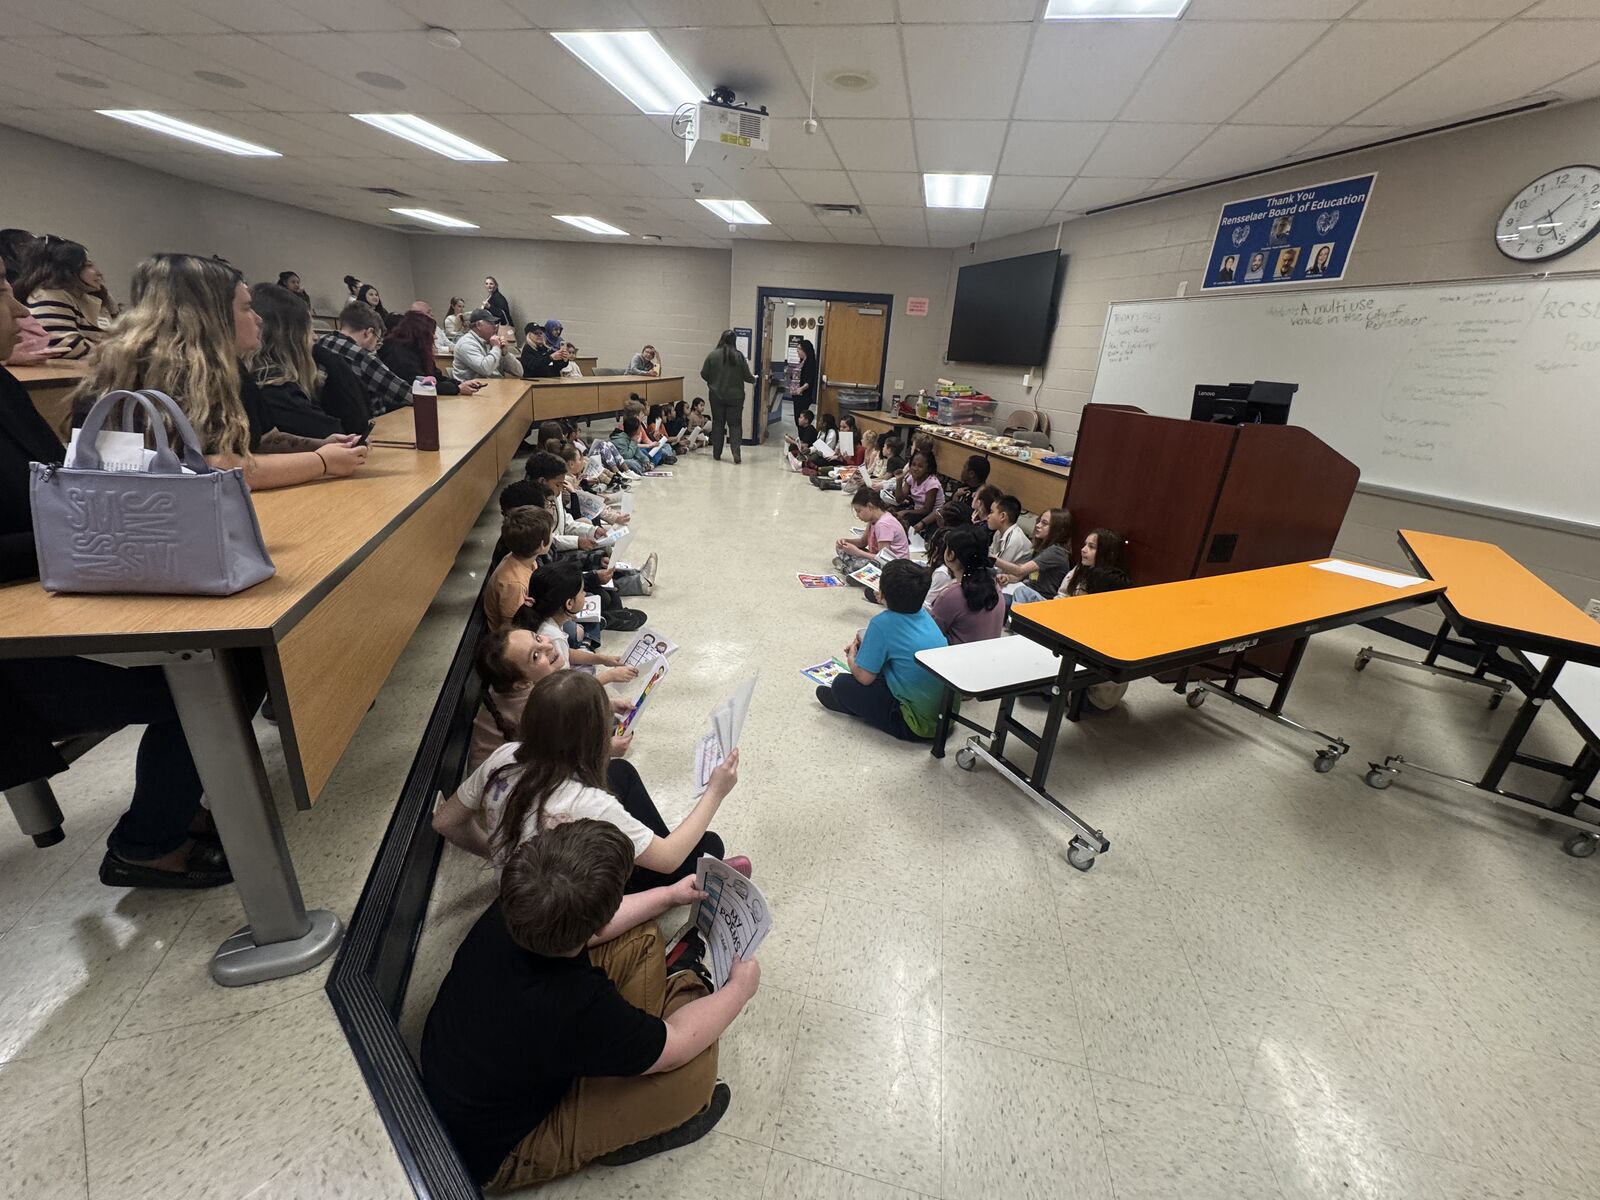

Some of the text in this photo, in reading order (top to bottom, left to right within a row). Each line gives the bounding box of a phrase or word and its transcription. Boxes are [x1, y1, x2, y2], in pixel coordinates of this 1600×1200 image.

[1556, 174, 1570, 185] 12
[1579, 175, 1587, 184] 1
[1533, 183, 1546, 194] 11
[1590, 184, 1600, 194] 2
[1266, 190, 1316, 208] Thank You
[1221, 192, 1366, 227] Rensselaer Board of Education
[1514, 200, 1529, 211] 10
[1505, 218, 1514, 228] 9
[1557, 235, 1567, 246] 5
[1517, 242, 1526, 253] 7
[1535, 243, 1545, 254] 6
[1300, 302, 1311, 316] A
[1313, 298, 1347, 315] multi
[1349, 297, 1375, 312] use
